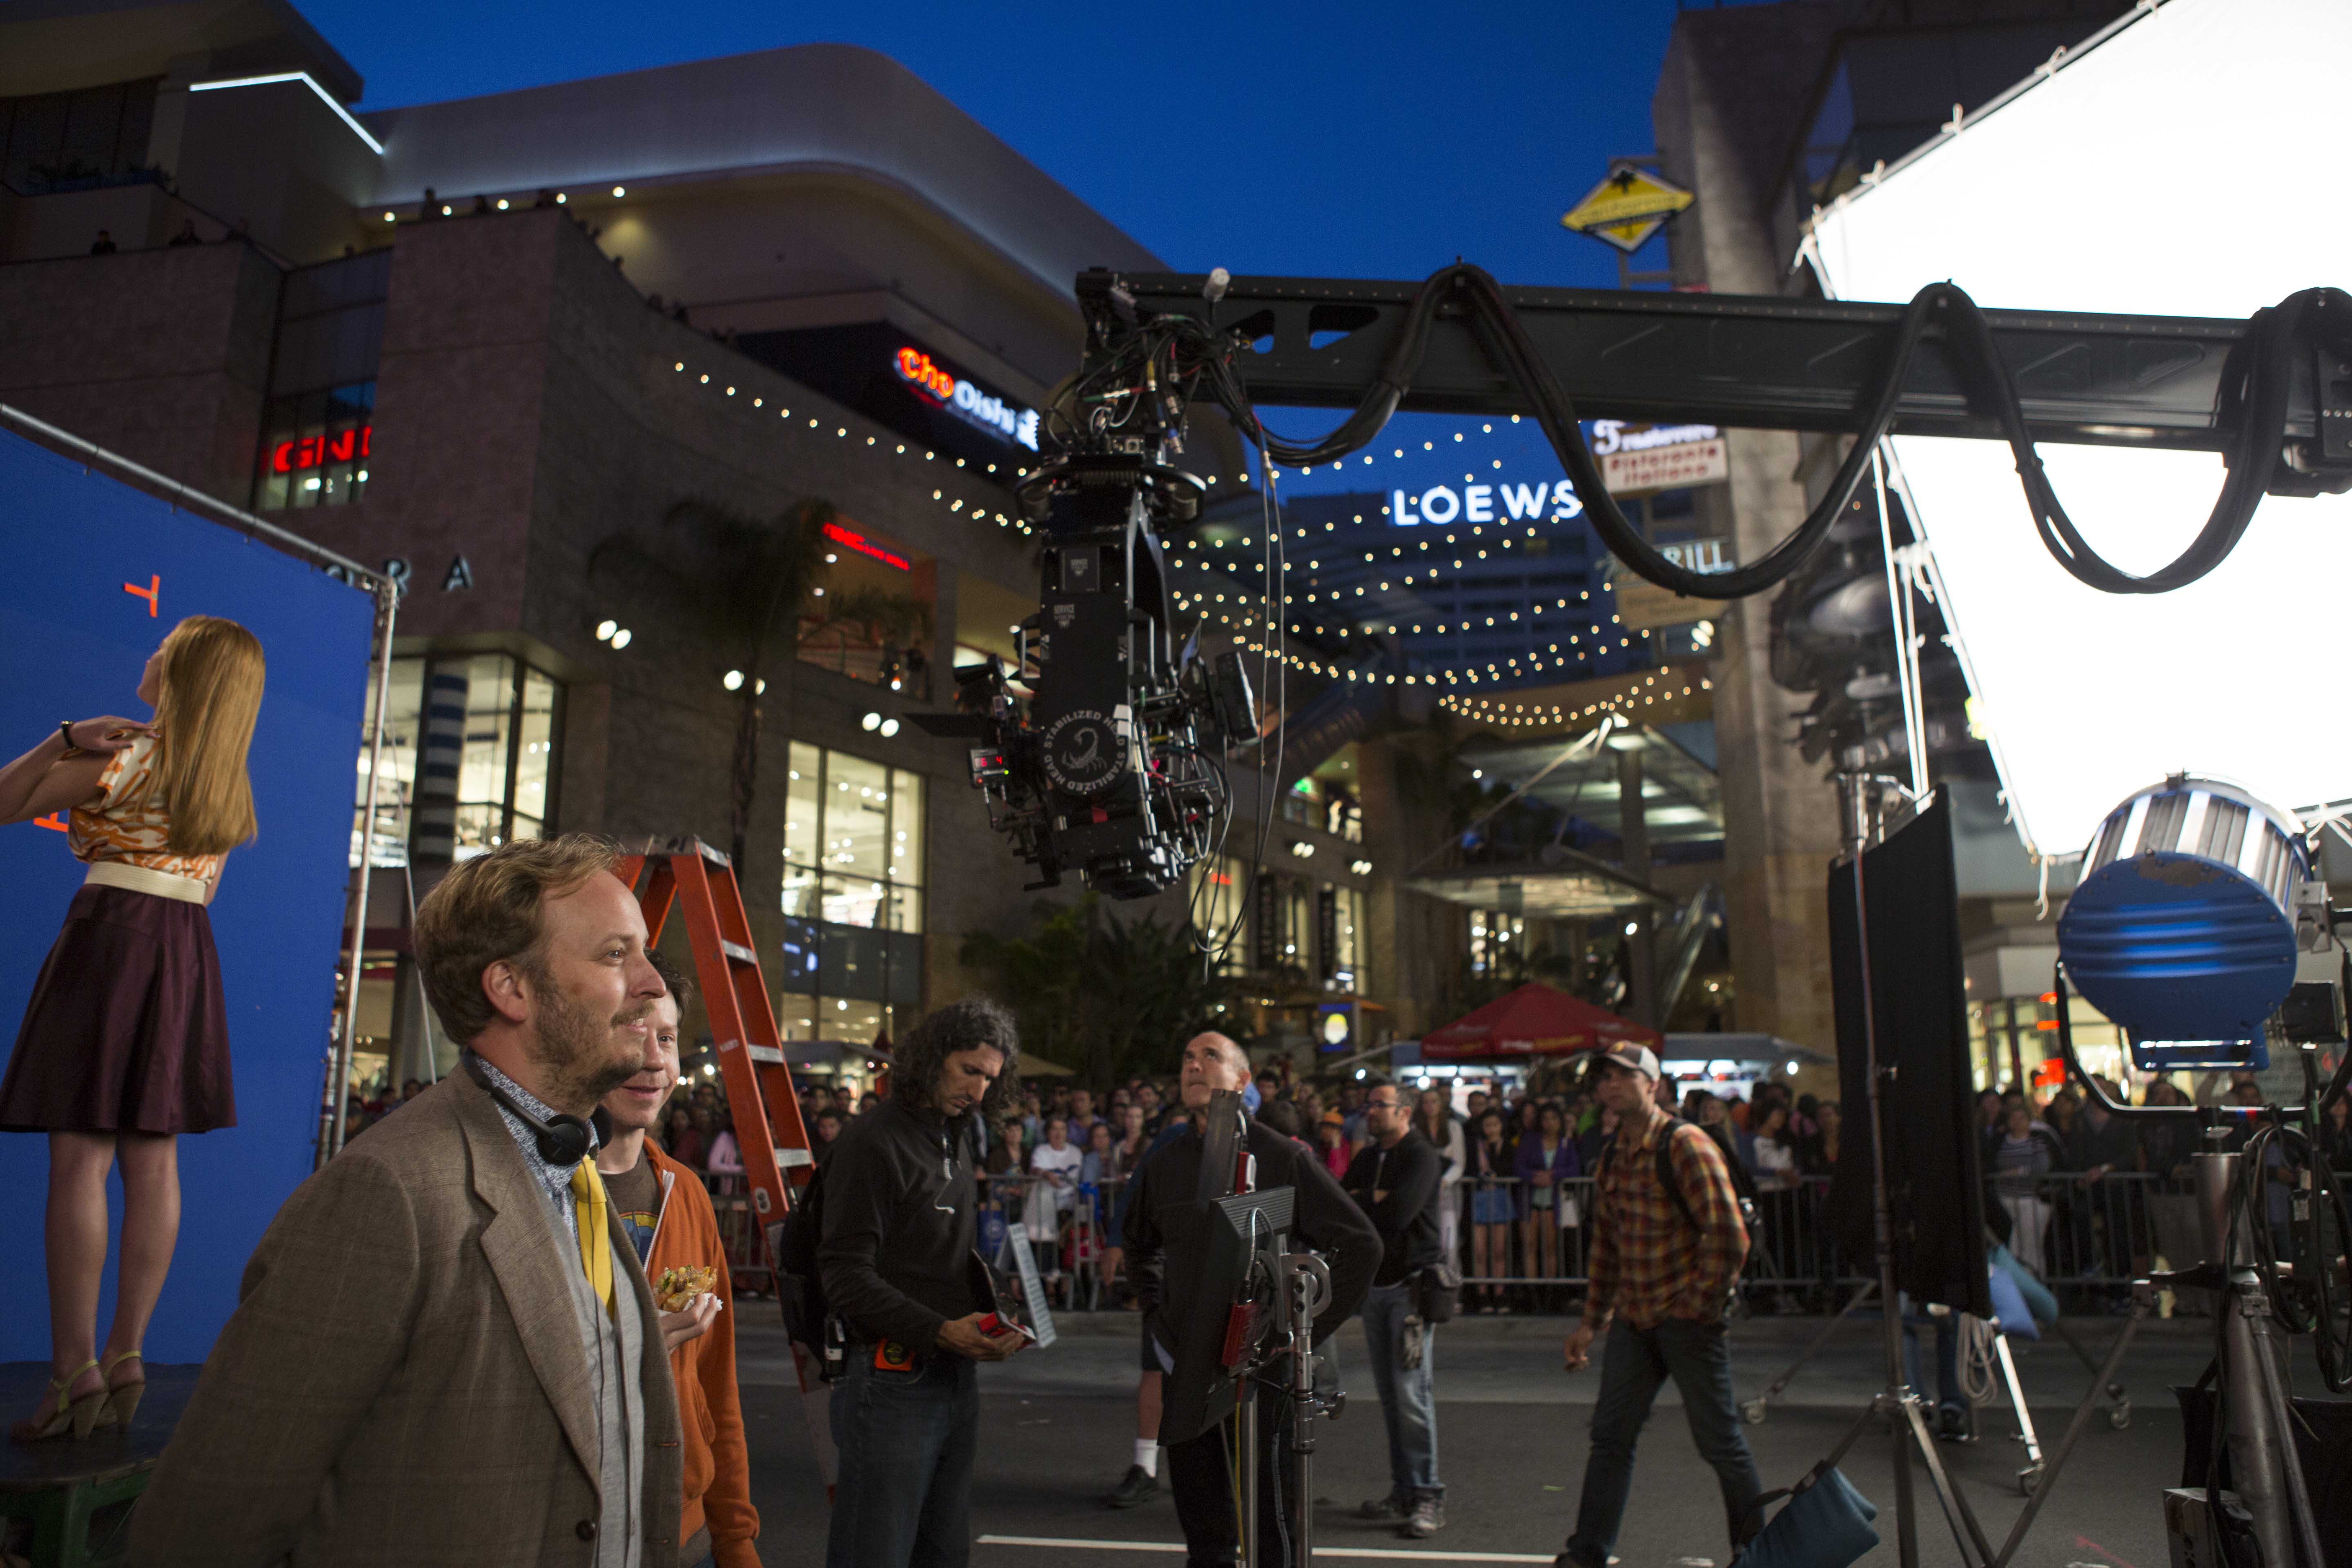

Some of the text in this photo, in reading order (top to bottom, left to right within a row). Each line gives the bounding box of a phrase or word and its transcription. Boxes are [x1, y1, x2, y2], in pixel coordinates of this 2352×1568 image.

[898, 347, 954, 398] Cho
[1393, 479, 1582, 526] LOEWS
[1043, 710, 1102, 749] STABILIZED
[1044, 752, 1126, 791] STABILIZED HEAD
